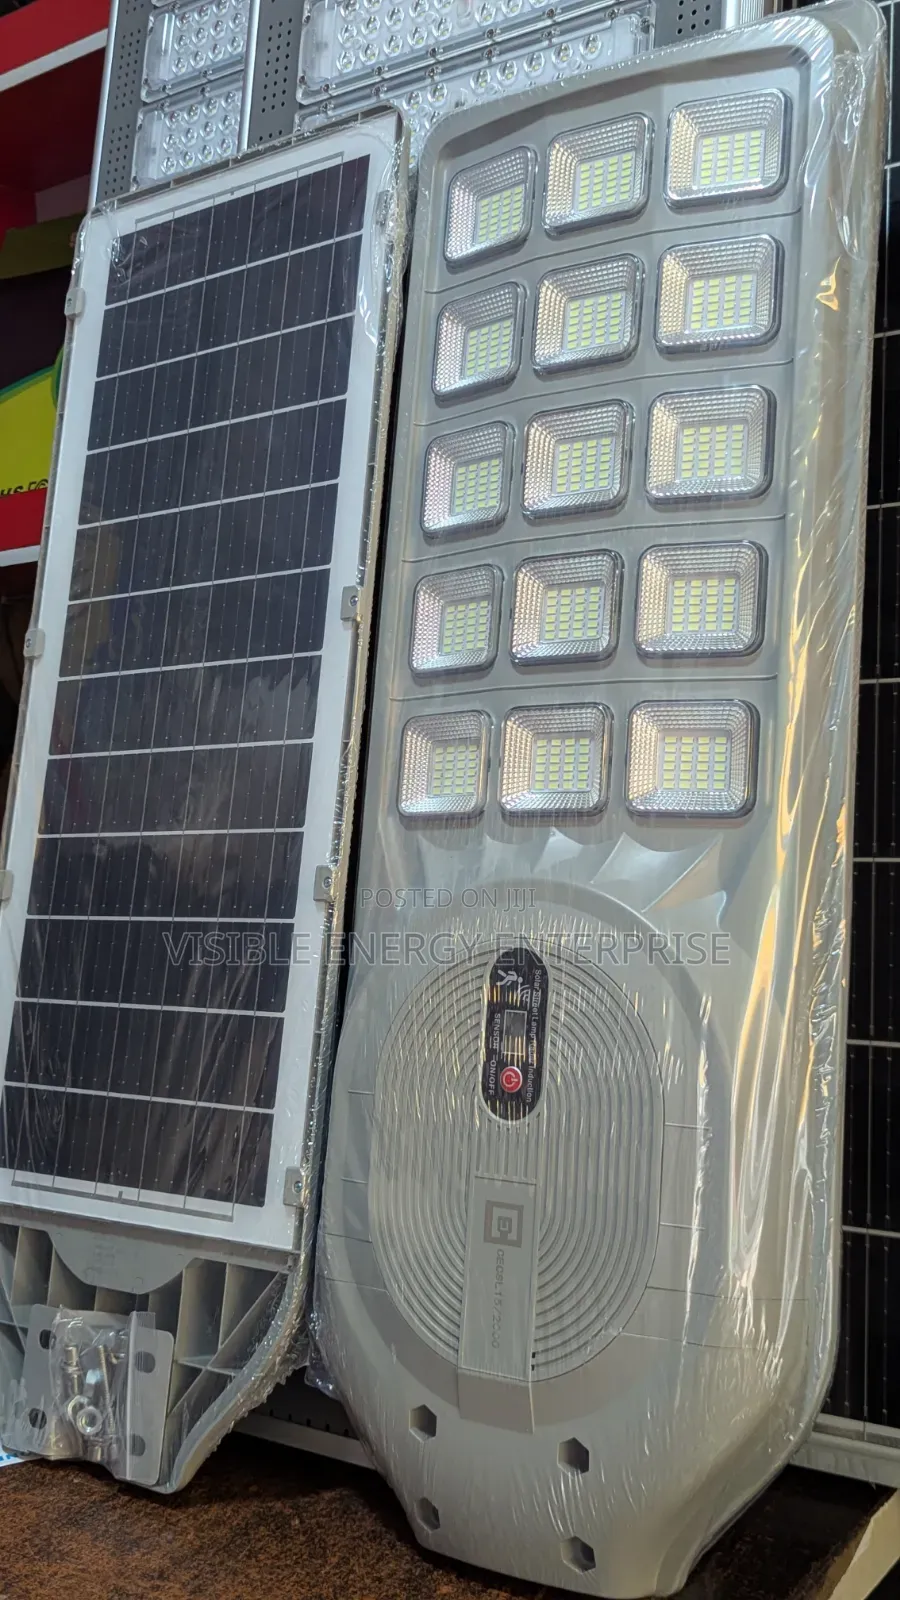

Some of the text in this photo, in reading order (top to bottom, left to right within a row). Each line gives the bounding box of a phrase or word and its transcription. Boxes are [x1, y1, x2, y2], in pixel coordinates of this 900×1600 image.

[533, 969, 542, 989] Solar
[532, 990, 541, 1015] Street
[492, 1013, 501, 1050] SENSOR
[529, 1015, 539, 1040] Lamp
[488, 1060, 497, 1095] ON/OFF
[525, 1064, 536, 1103] Induction
